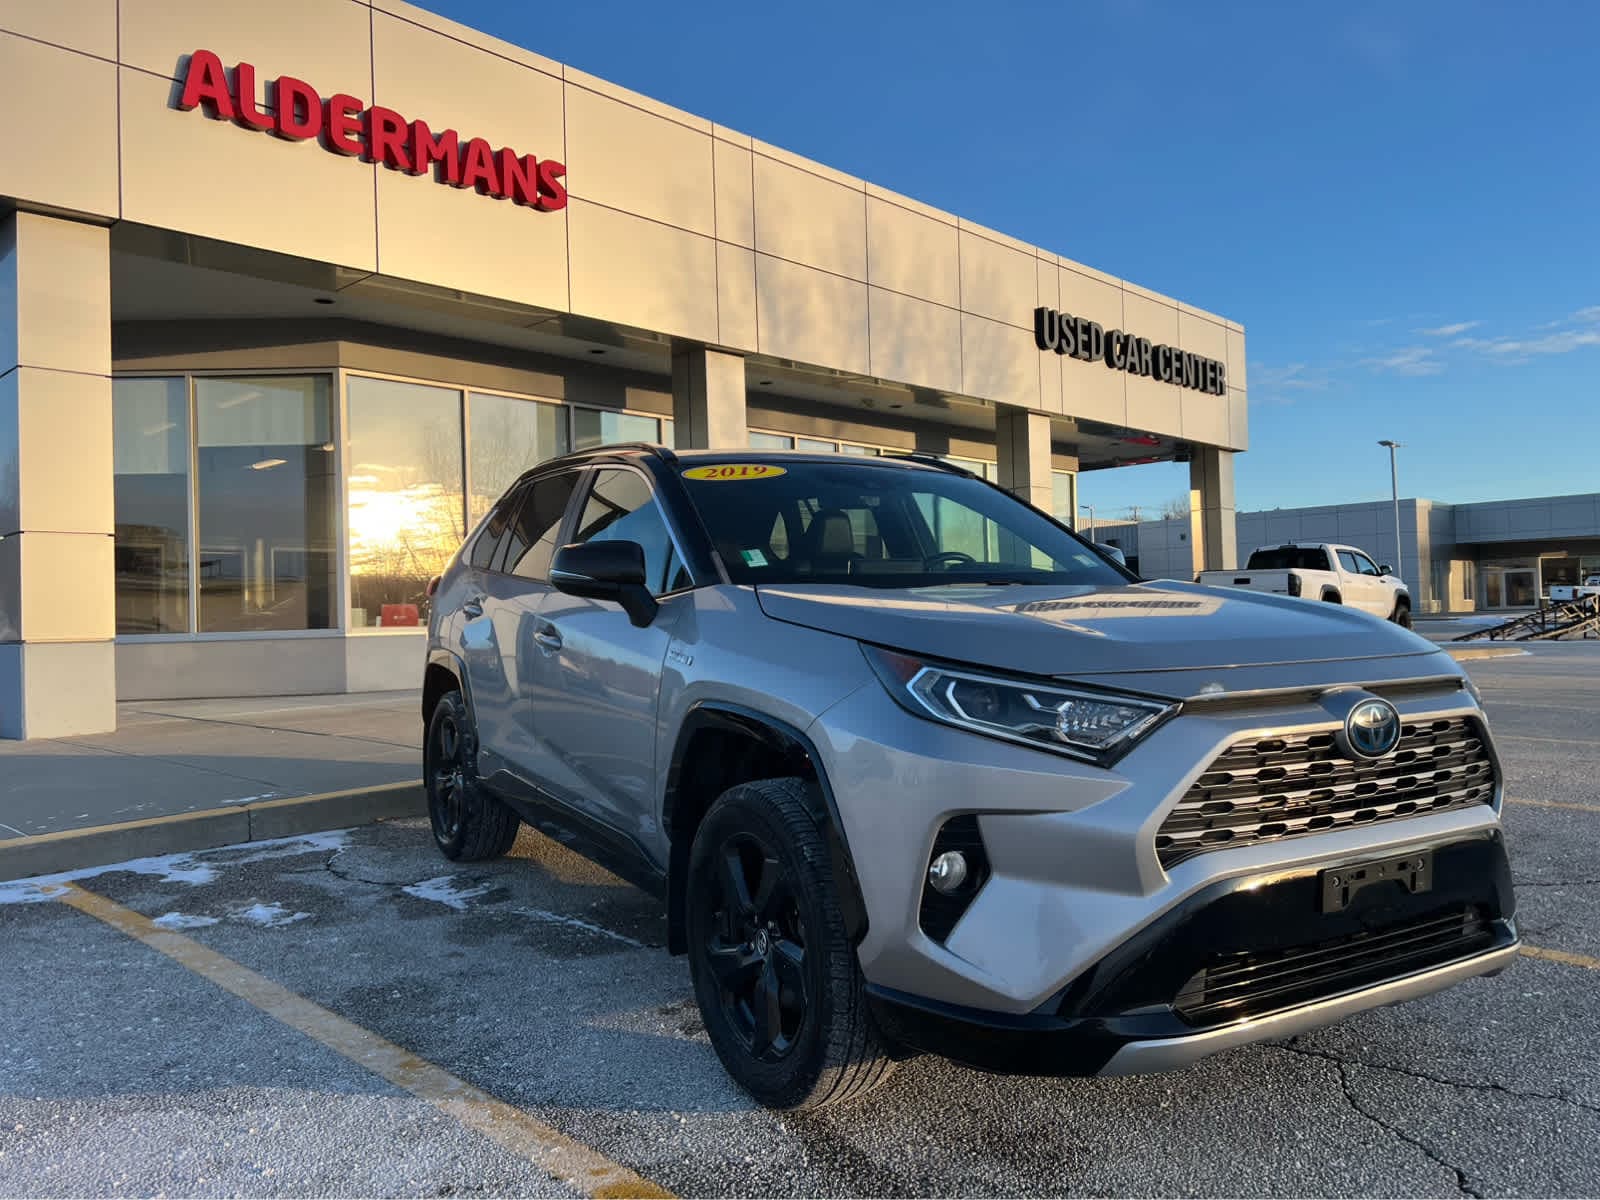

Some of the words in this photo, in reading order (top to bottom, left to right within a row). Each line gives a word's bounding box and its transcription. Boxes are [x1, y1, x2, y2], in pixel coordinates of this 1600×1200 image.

[181, 49, 567, 212] ALDERMANS
[1036, 307, 1105, 362] USED
[1106, 329, 1154, 377] CAR
[1155, 344, 1227, 396] CENTER
[703, 466, 768, 478] 2019
